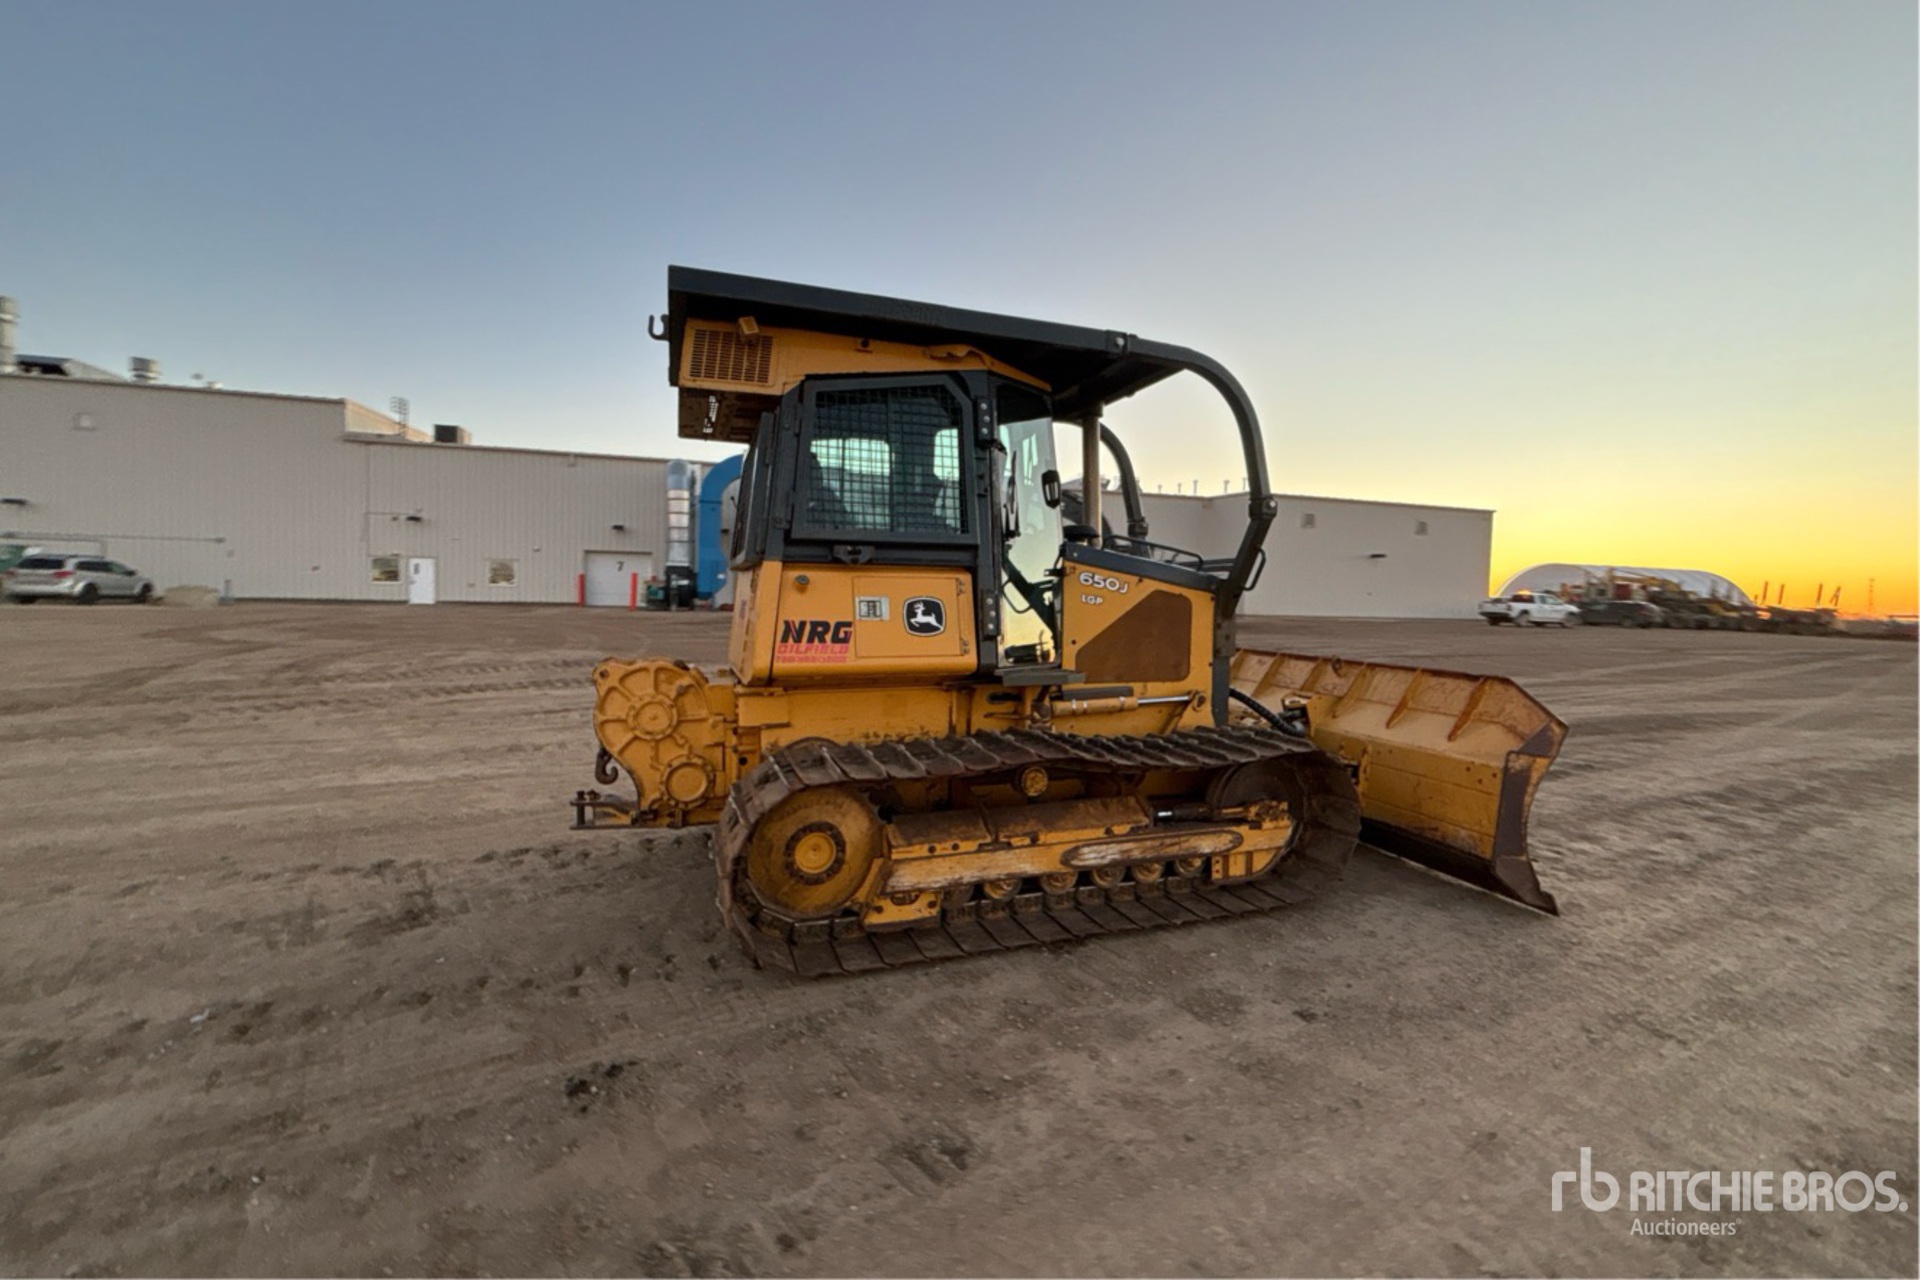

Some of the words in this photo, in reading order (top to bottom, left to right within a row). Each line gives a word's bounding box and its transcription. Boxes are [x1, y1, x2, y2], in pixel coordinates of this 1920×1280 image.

[1079, 572, 1129, 593] 650J
[1081, 594, 1104, 605] LGP
[780, 620, 853, 644] NRG
[777, 644, 850, 654] OILFIELD
